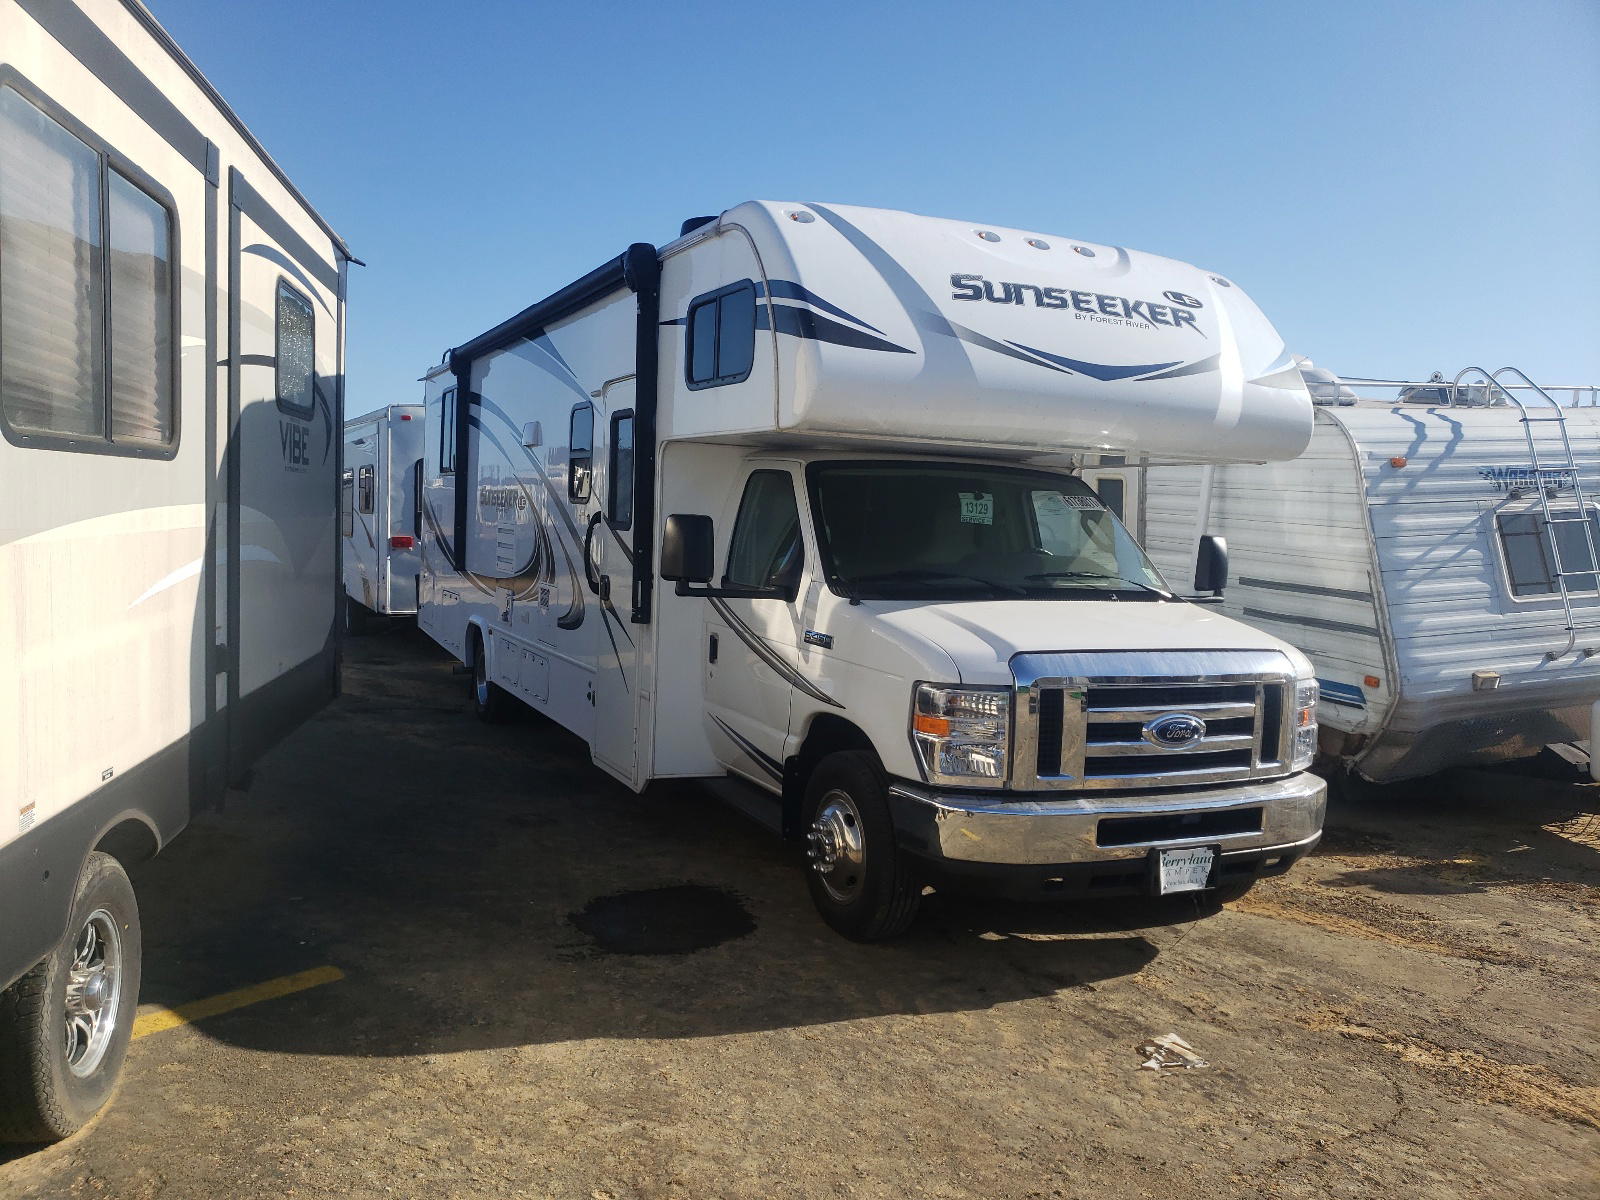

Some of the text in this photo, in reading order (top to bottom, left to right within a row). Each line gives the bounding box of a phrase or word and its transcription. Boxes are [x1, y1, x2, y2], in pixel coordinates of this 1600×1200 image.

[950, 273, 1207, 339] SUNSEEKER LE
[279, 420, 310, 464] VIBE
[965, 502, 989, 515] 13129
[1166, 723, 1193, 738] Ford
